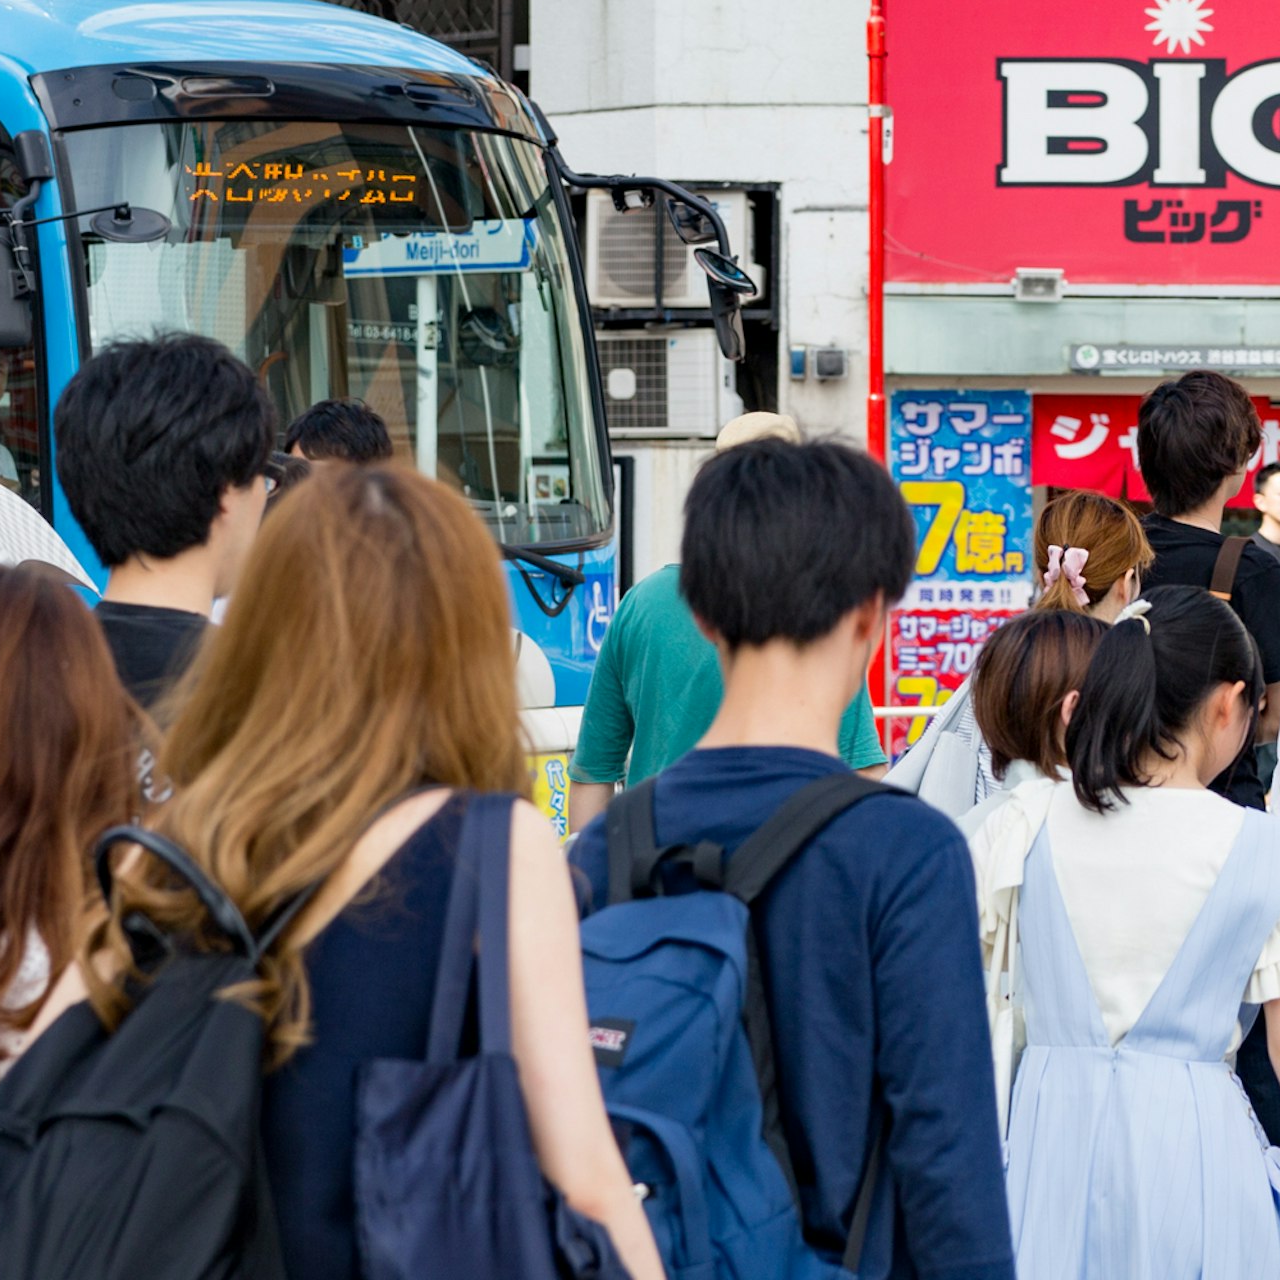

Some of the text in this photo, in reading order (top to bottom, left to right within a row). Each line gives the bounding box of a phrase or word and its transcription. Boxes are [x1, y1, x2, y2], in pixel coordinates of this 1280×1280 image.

[1123, 198, 1264, 244] ビッグ
[405, 239, 481, 265] Meiji-dori
[899, 401, 1025, 436] サマー
[899, 438, 1025, 477] ジャンボ
